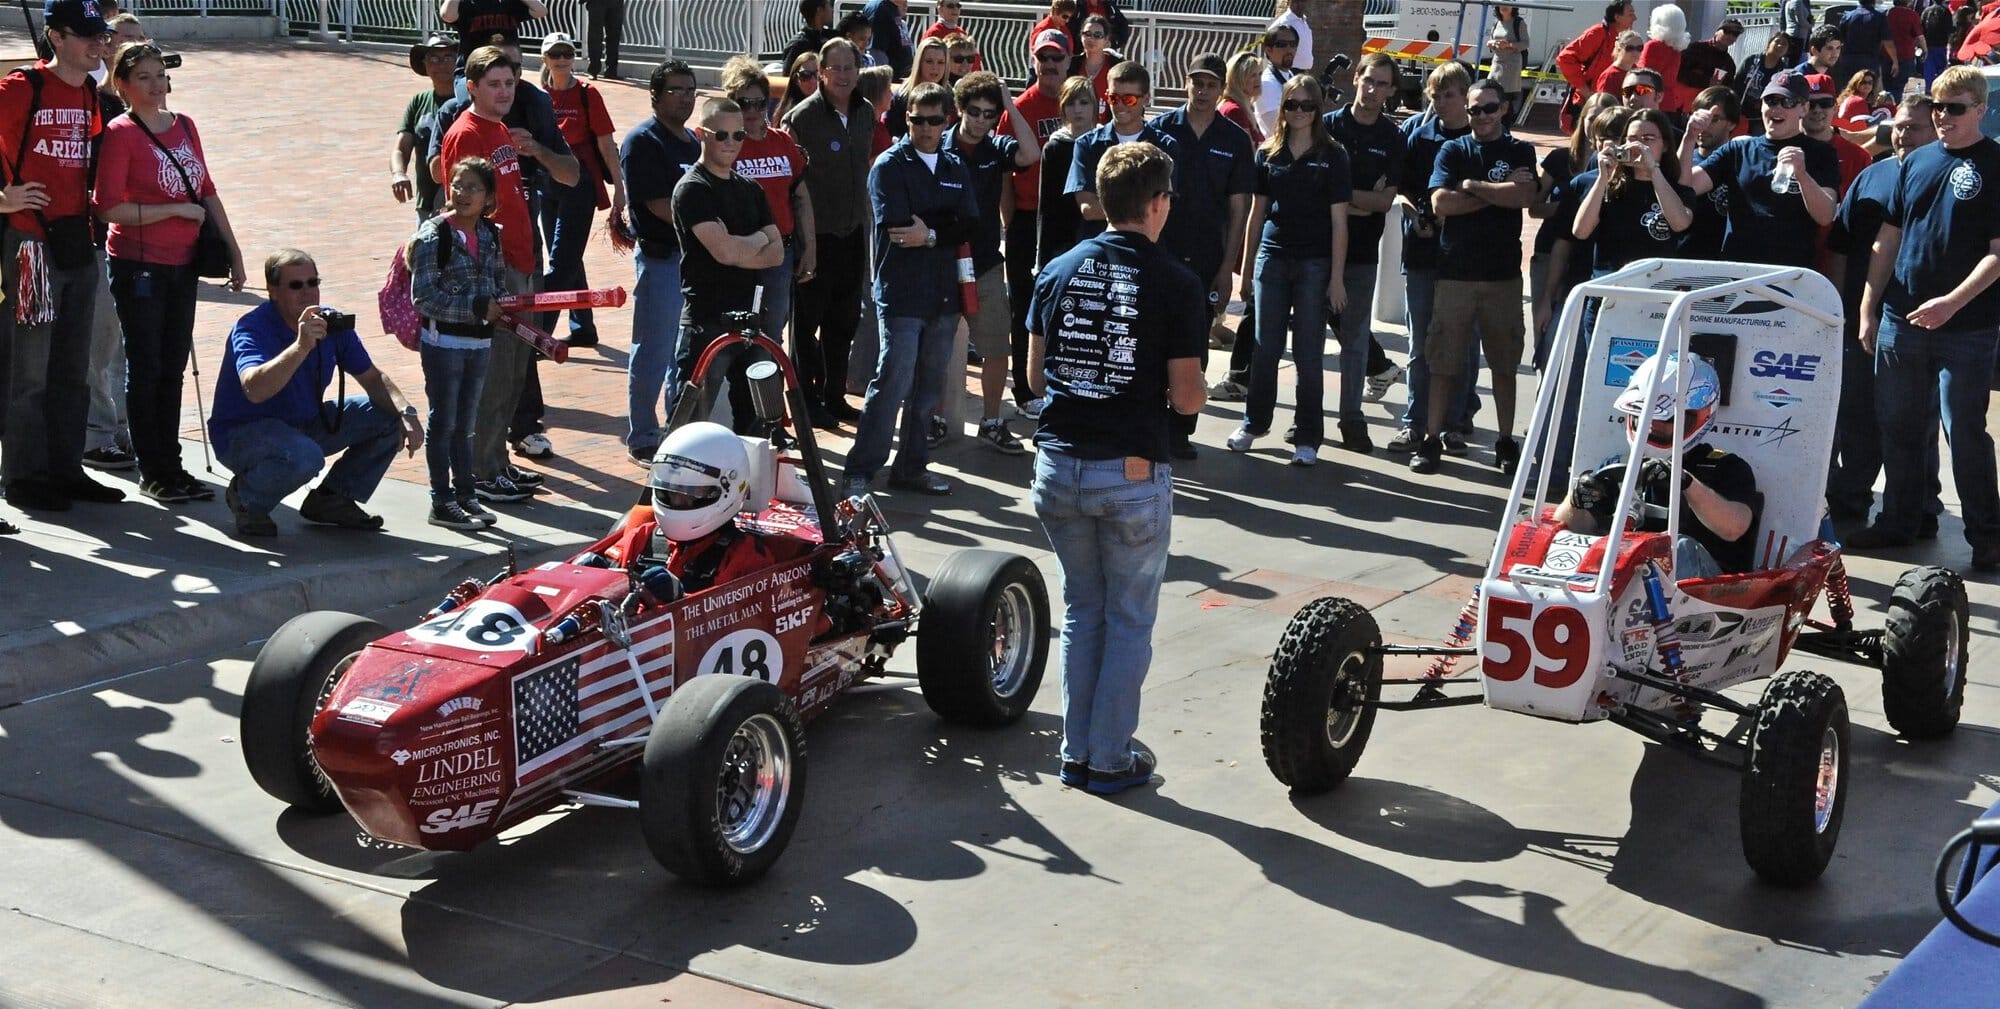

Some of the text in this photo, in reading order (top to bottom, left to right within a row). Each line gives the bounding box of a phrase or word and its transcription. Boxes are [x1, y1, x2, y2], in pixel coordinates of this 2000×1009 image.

[34, 110, 54, 126] THE
[1096, 261, 1141, 275] THE UNIVERSITY
[1098, 270, 1107, 278] OF
[1689, 314, 1713, 323] BORNE
[1773, 320, 1787, 328] INC.
[1749, 350, 1822, 381] SAE
[1710, 425, 1763, 437] ARTIN
[681, 562, 813, 621] THE UNIVERSITY OF ARIZONA
[419, 605, 526, 646] 48
[686, 602, 763, 641] THE METAL MAN
[775, 605, 814, 635] SKF
[1625, 598, 1651, 627] SA
[1482, 596, 1590, 688] 59
[1627, 642, 1648, 652] ROD
[712, 638, 770, 680] 48
[436, 697, 481, 717] NHBB
[420, 724, 433, 732] New
[433, 718, 460, 730] Hampshire
[460, 714, 470, 722] Ball
[412, 730, 501, 761] MICRO-TRONICS, INC.
[416, 746, 501, 784] LINDEL
[409, 786, 500, 806] Precision CNC Machining
[412, 770, 501, 798] ENGINEERING
[419, 799, 499, 834] SAE
